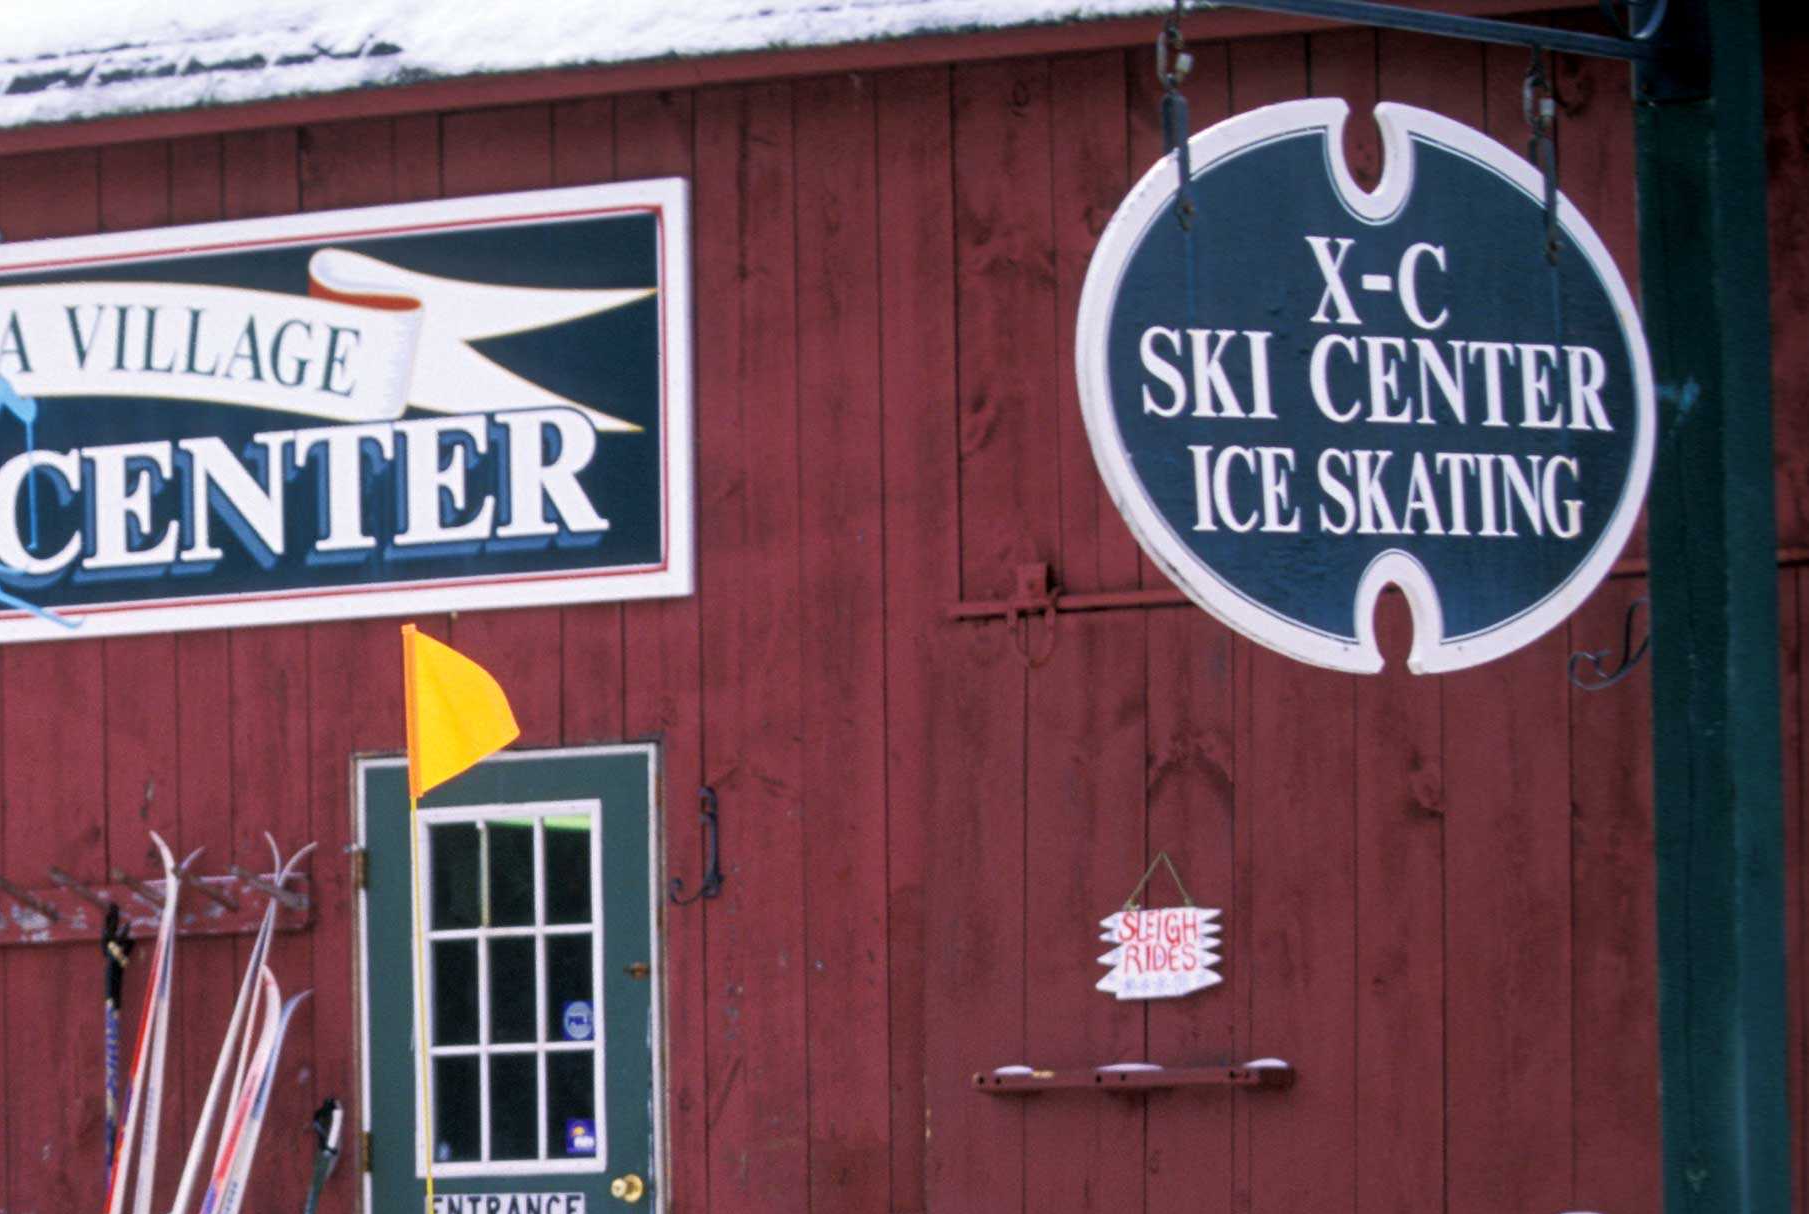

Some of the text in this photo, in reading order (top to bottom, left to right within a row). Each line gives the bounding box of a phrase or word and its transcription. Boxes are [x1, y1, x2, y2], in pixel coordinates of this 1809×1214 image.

[1303, 235, 1450, 331] X-C
[64, 303, 364, 398] VILLAGE
[1139, 325, 1614, 432] SKI CENTER
[1187, 444, 1584, 539] ICE SKATING
[1119, 910, 1199, 946] SLEIGH
[1123, 944, 1197, 974] RIDES
